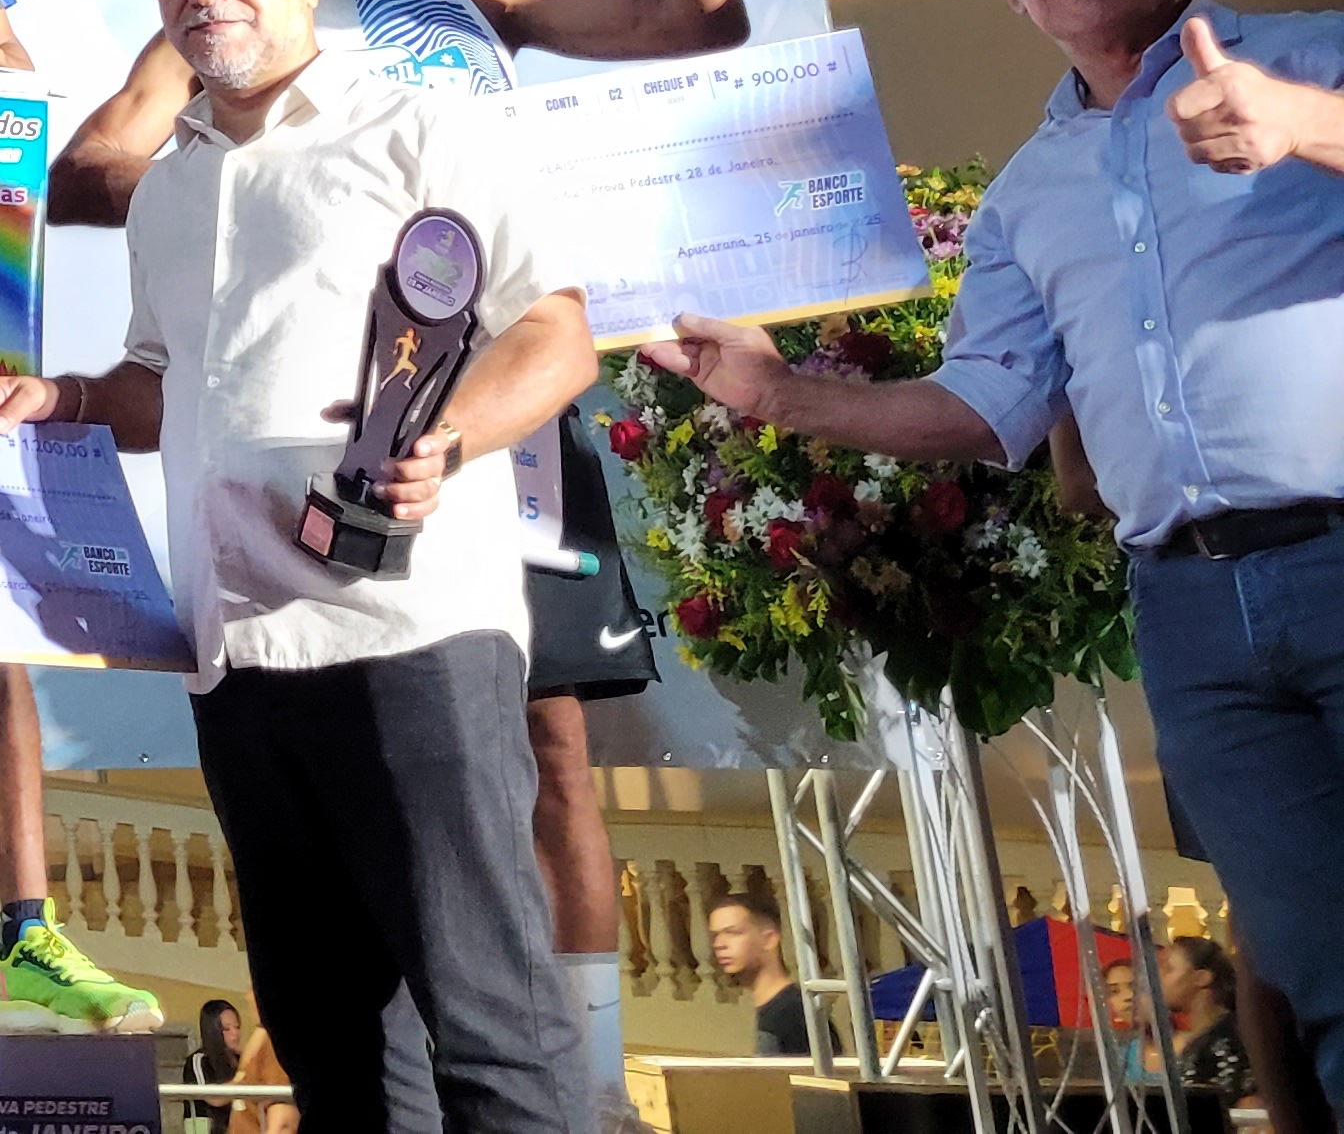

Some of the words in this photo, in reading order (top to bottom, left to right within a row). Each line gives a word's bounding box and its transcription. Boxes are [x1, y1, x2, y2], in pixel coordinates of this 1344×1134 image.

[751, 63, 819, 88] 900,00
[546, 95, 580, 112] CONTA
[609, 88, 624, 101] C2
[643, 77, 683, 96] CHEQUE
[630, 171, 681, 188] Pedestre
[686, 167, 703, 180] 28
[708, 162, 722, 175] de
[808, 174, 848, 194] BANCO
[812, 186, 863, 209] ESPORTE
[754, 233, 772, 244] 25
[790, 223, 833, 241] janeiro
[83, 546, 116, 561] BANCO
[89, 560, 131, 576] ESPORTE
[23, 1100, 110, 1116] PEDESTRE
